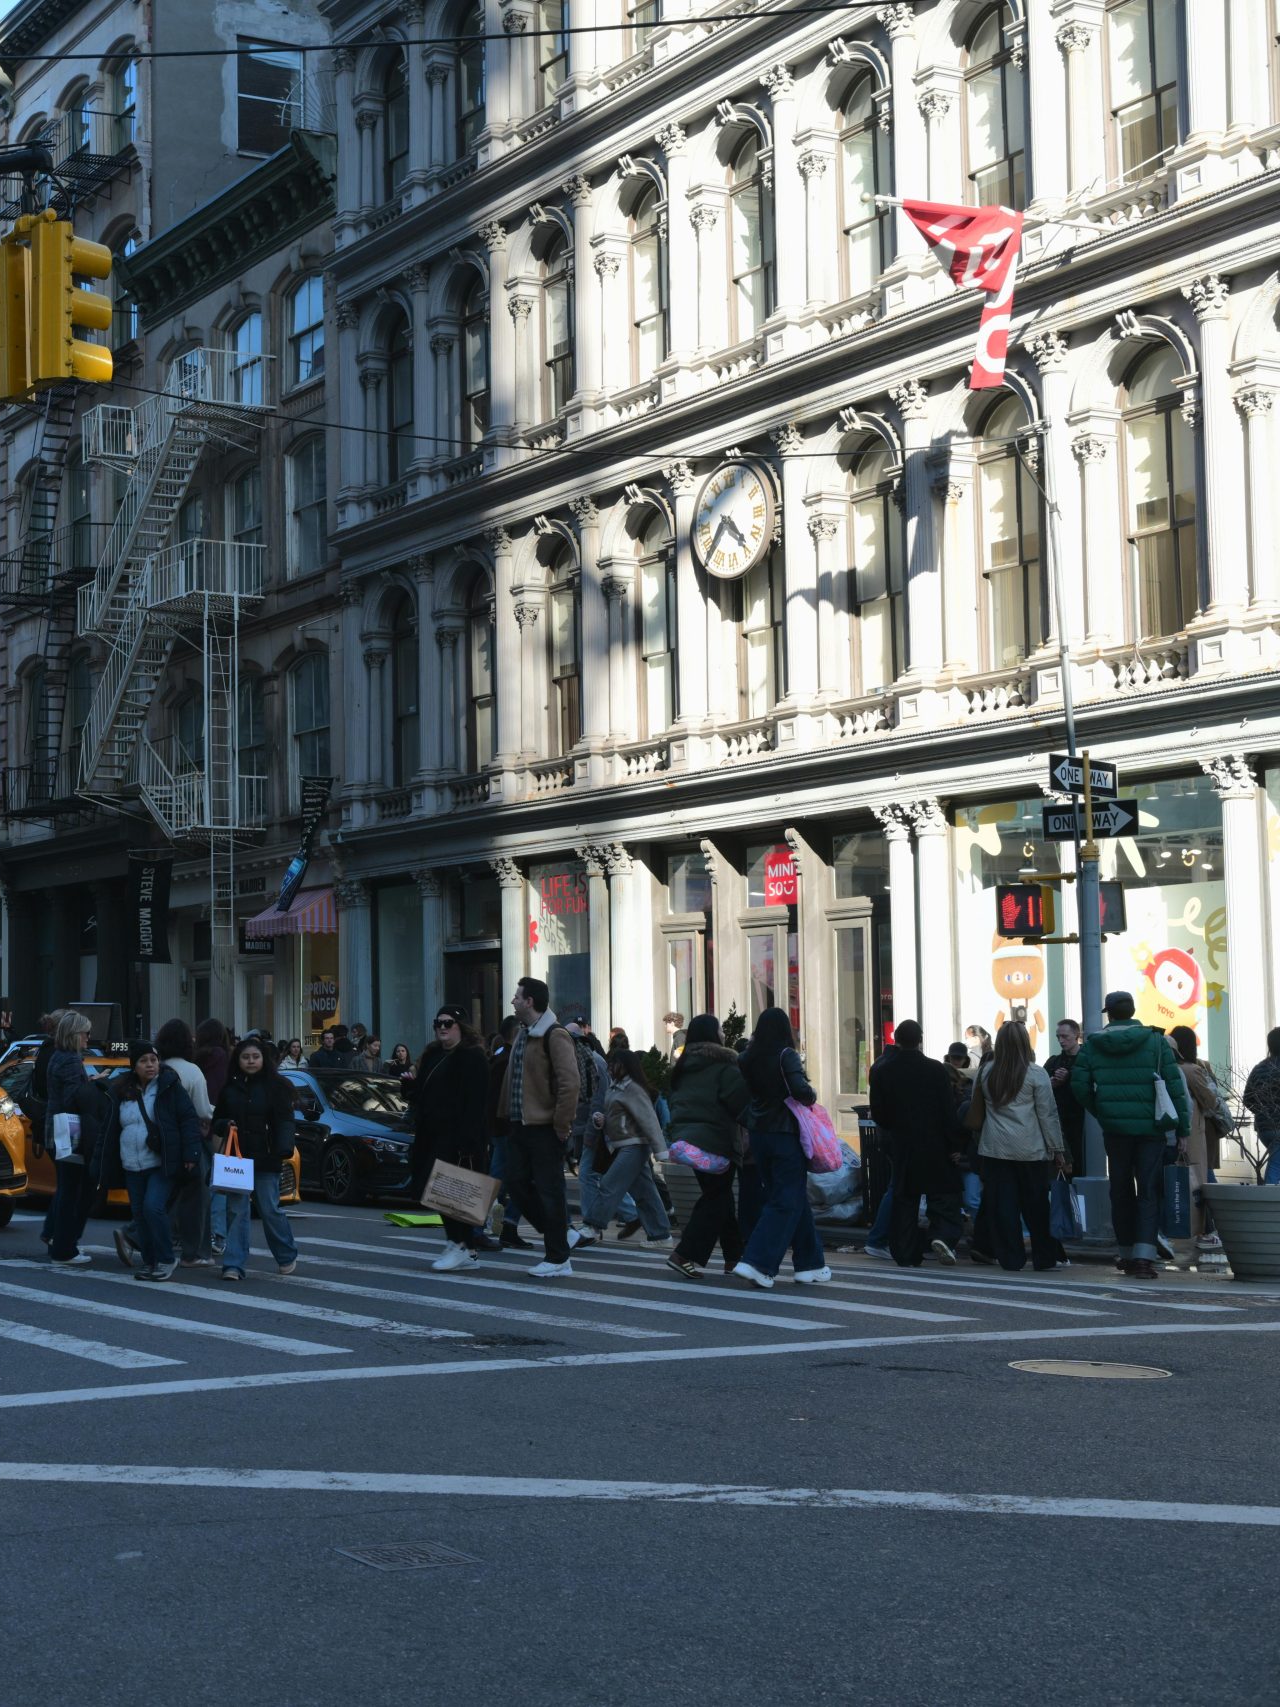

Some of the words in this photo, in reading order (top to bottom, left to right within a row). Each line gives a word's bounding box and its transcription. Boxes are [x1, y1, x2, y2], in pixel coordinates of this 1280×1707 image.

[1061, 766, 1080, 783] ONE
[1091, 812, 1119, 827] WAY
[768, 862, 794, 878] MINI
[140, 867, 155, 903] STEVE
[541, 873, 572, 899] LIFE
[573, 872, 588, 896] IS
[541, 898, 564, 917] FOR
[565, 896, 589, 915] FUN
[139, 907, 153, 955] MADDEN
[245, 941, 272, 950] MADDEN
[304, 981, 336, 996] SPRING
[1157, 1003, 1175, 1019] YOYO
[111, 1042, 129, 1052] 2P35
[223, 1166, 245, 1176] MoMA
